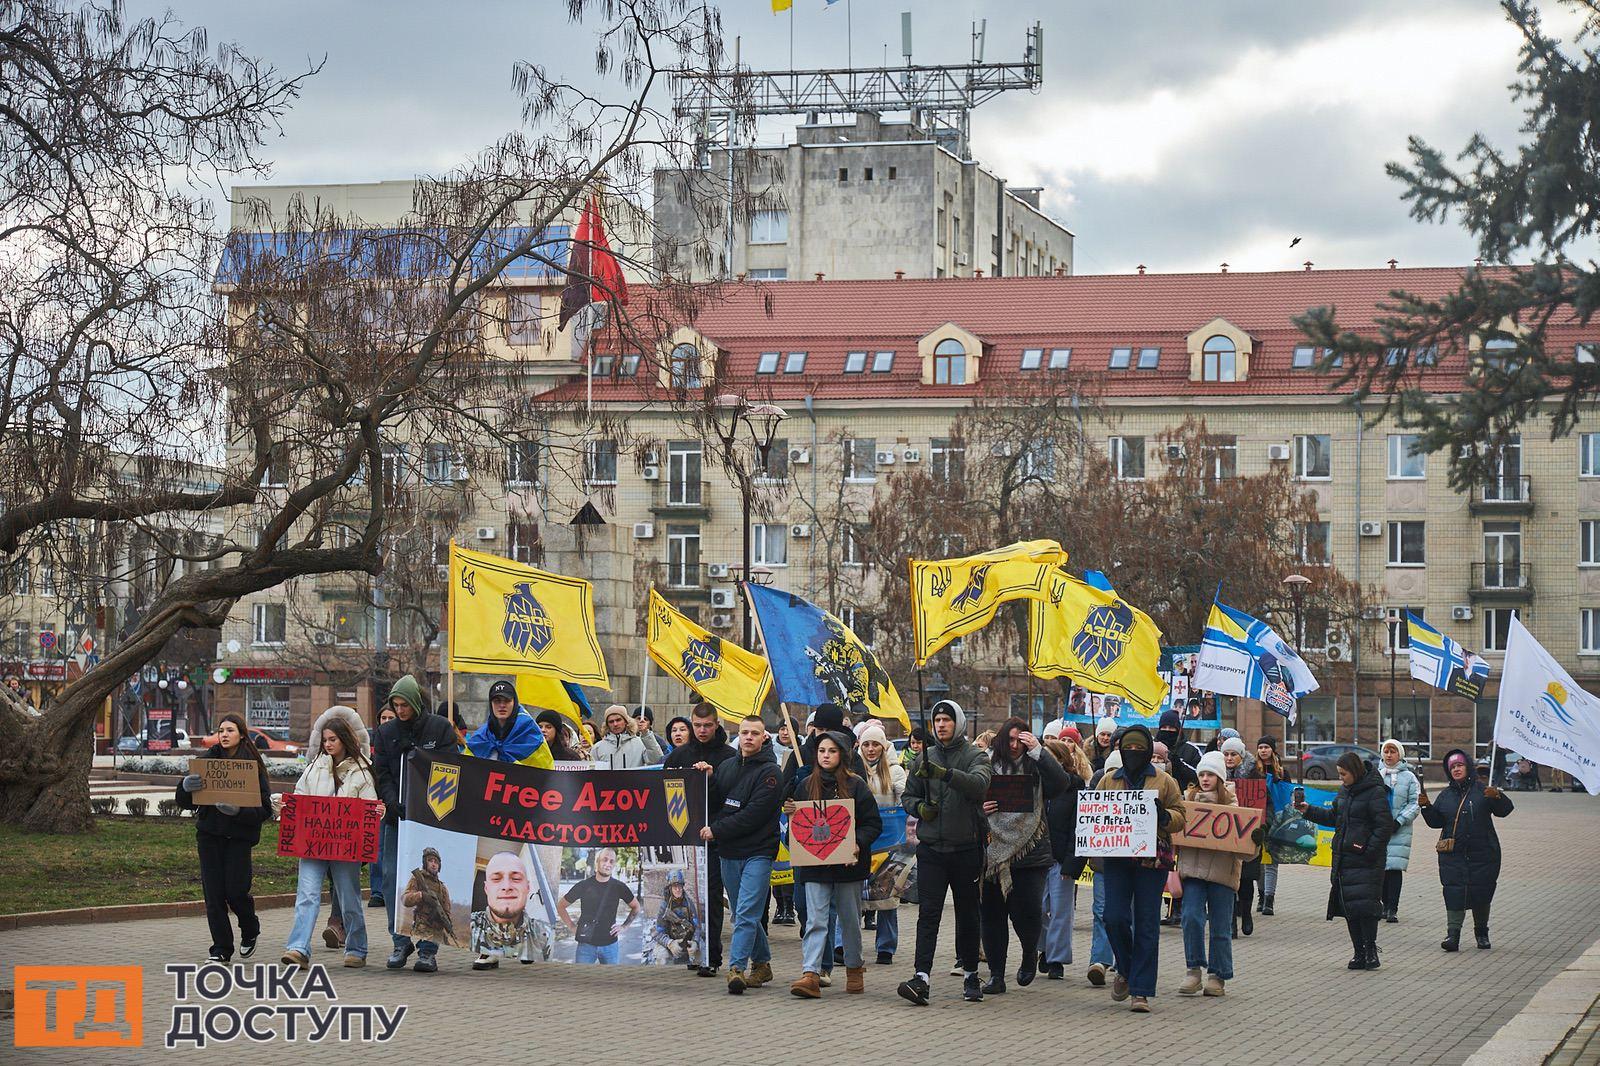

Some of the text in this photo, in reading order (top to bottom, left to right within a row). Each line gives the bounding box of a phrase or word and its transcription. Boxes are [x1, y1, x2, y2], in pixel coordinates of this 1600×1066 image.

[508, 612, 554, 629] АЗОВ
[1084, 623, 1132, 644] АЗОВ
[205, 770, 229, 779] AZOV
[434, 766, 457, 774] АЗОВ
[211, 780, 246, 789] ПОЛОНУ!
[484, 771, 650, 811] Free Azov
[1079, 791, 1144, 802] ХТО НЕ СТАЄ
[312, 801, 352, 816] ТИ ЇХ
[304, 816, 360, 830] НАДІЯ НА
[1078, 815, 1101, 824] СТАЄ
[1184, 808, 1259, 839] ZOV
[312, 829, 352, 841] ВІЛЬНЕ
[1093, 824, 1133, 834] ВОРОГОМ
[281, 825, 296, 853] FREE
[1077, 836, 1088, 848] НА
